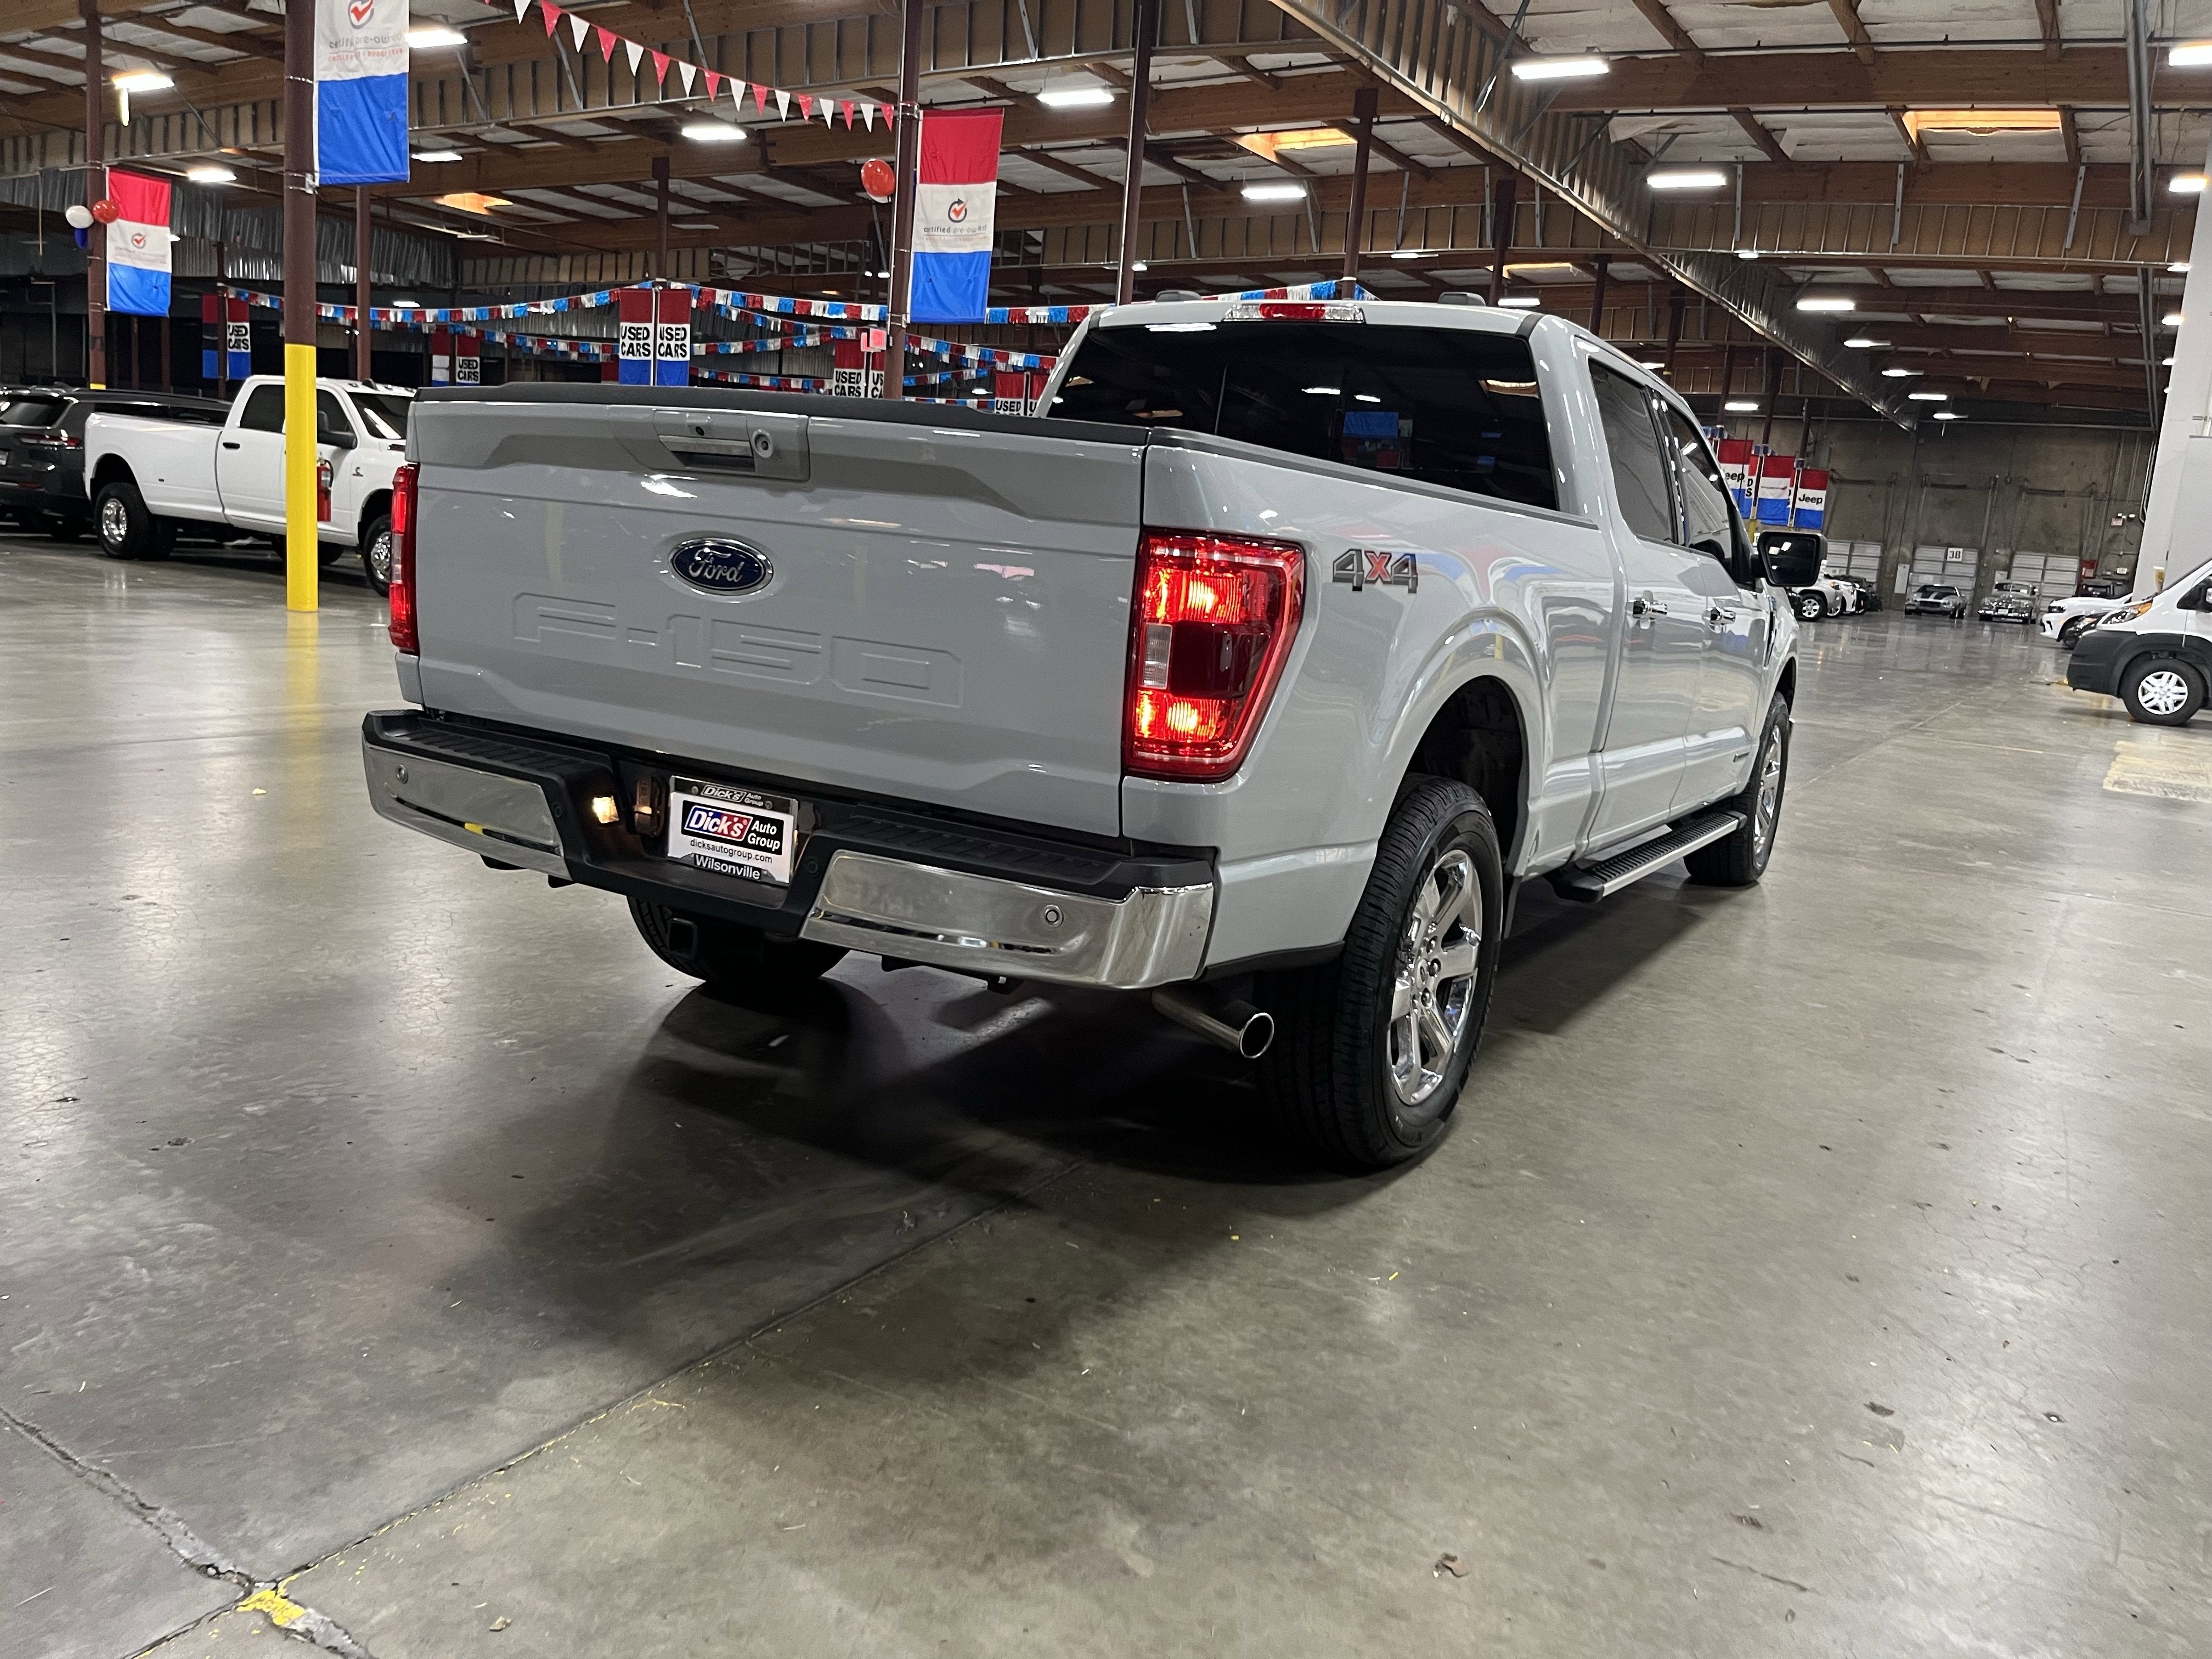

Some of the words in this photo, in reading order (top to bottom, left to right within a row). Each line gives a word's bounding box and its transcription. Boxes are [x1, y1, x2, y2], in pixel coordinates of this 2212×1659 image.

[923, 225, 951, 234] cetified
[953, 224, 987, 235] pre-owed
[621, 325, 650, 341] USED
[659, 326, 687, 341] USED
[228, 338, 249, 350] CAS
[621, 342, 651, 357] CARS
[658, 343, 687, 358] CARS
[458, 358, 478, 369] USED
[836, 370, 862, 385] USED
[834, 384, 861, 397] CARS
[996, 399, 1022, 412] USED
[1725, 472, 1745, 483] eep
[1798, 494, 1823, 505] Jeep
[1949, 550, 1961, 558] 38
[689, 548, 745, 582] Ford
[512, 592, 963, 708] F-150
[704, 787, 741, 800] Dick's
[744, 798, 764, 806] Group
[689, 809, 744, 837] Dick's
[751, 820, 777, 835] Auto
[747, 832, 780, 851] Group
[690, 838, 773, 864] dicksautogroup.com
[695, 854, 760, 879] Wilsonville
